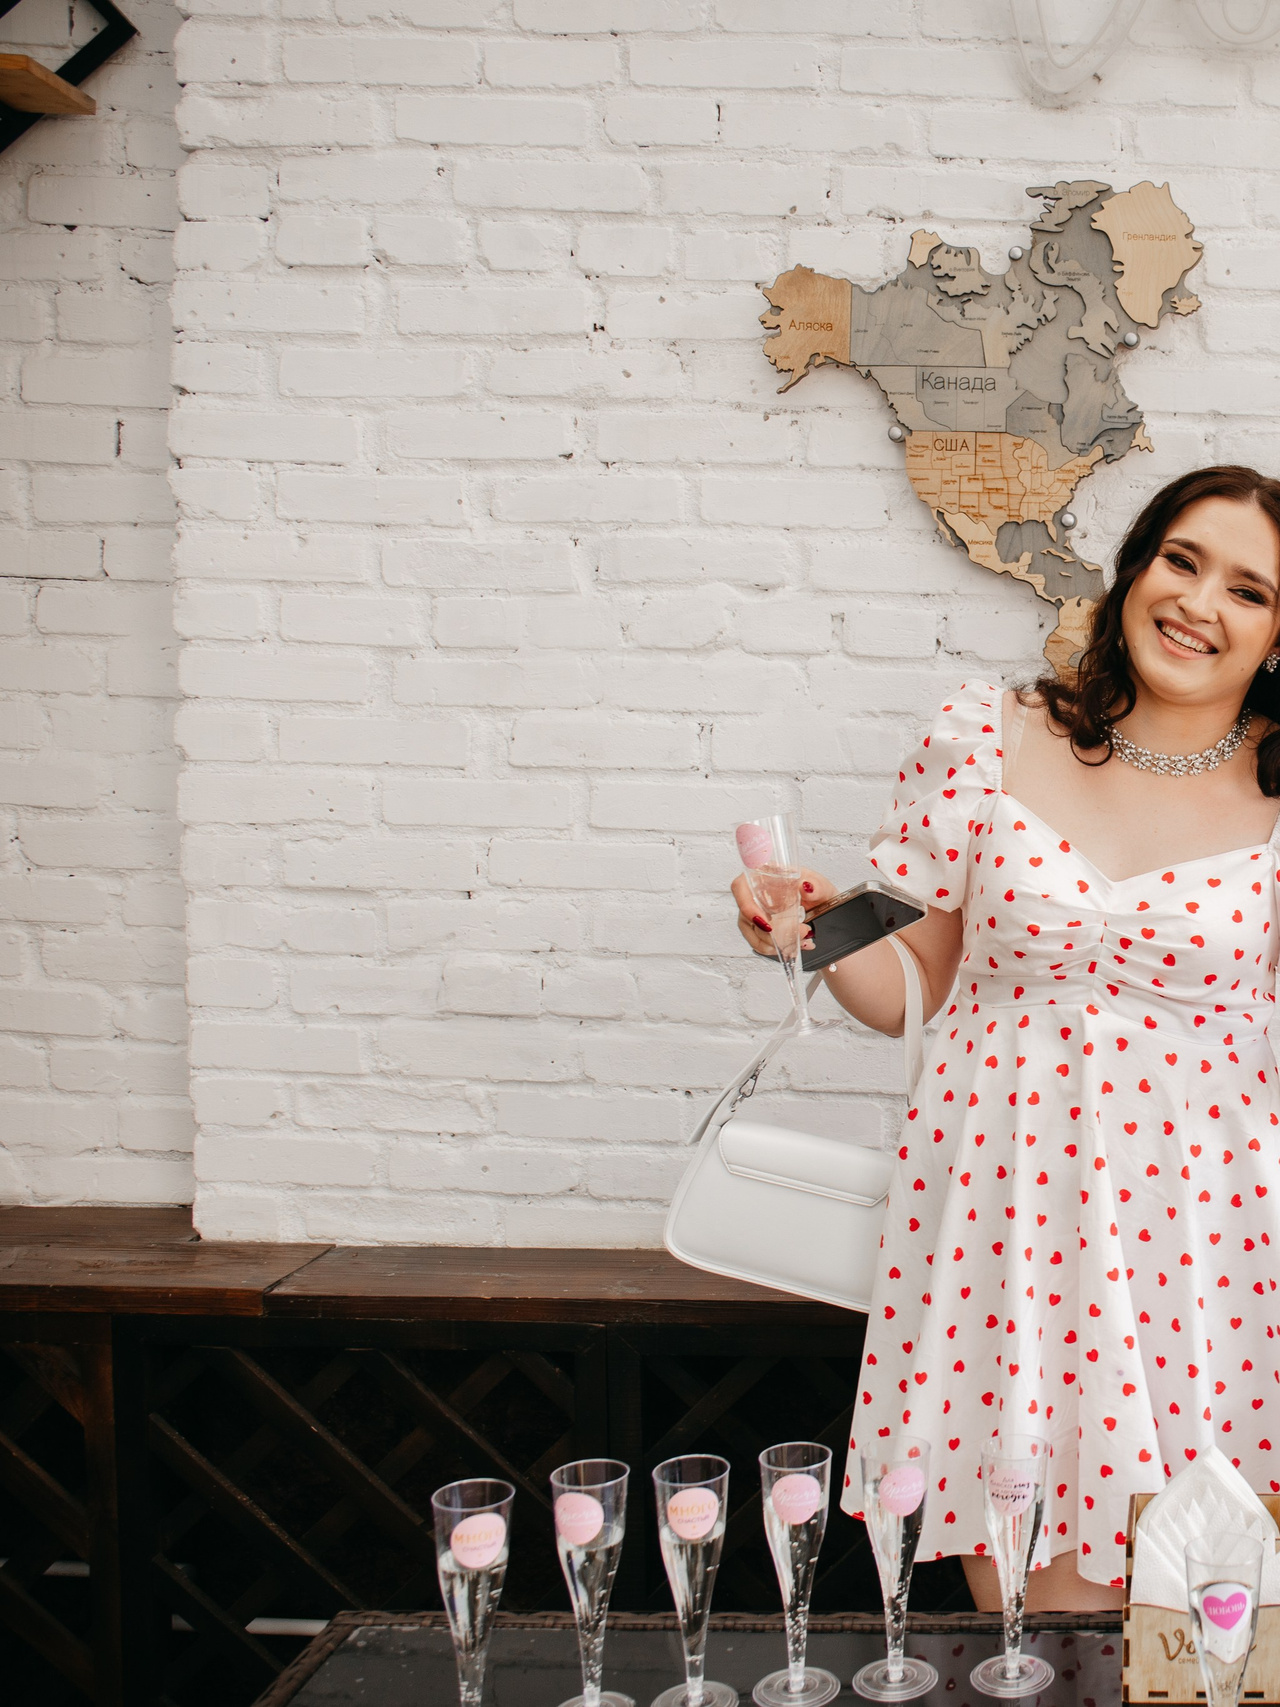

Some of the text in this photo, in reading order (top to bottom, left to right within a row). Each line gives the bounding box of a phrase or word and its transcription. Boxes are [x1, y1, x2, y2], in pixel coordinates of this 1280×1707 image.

[1122, 231, 1177, 243] Гренландия
[788, 319, 834, 332] Аляска
[921, 371, 998, 394] Канада
[933, 438, 971, 452] США
[967, 538, 994, 547] Мексика
[669, 1499, 718, 1518] МНОГО
[1206, 1601, 1246, 1616] ЛЮБОВЬ
